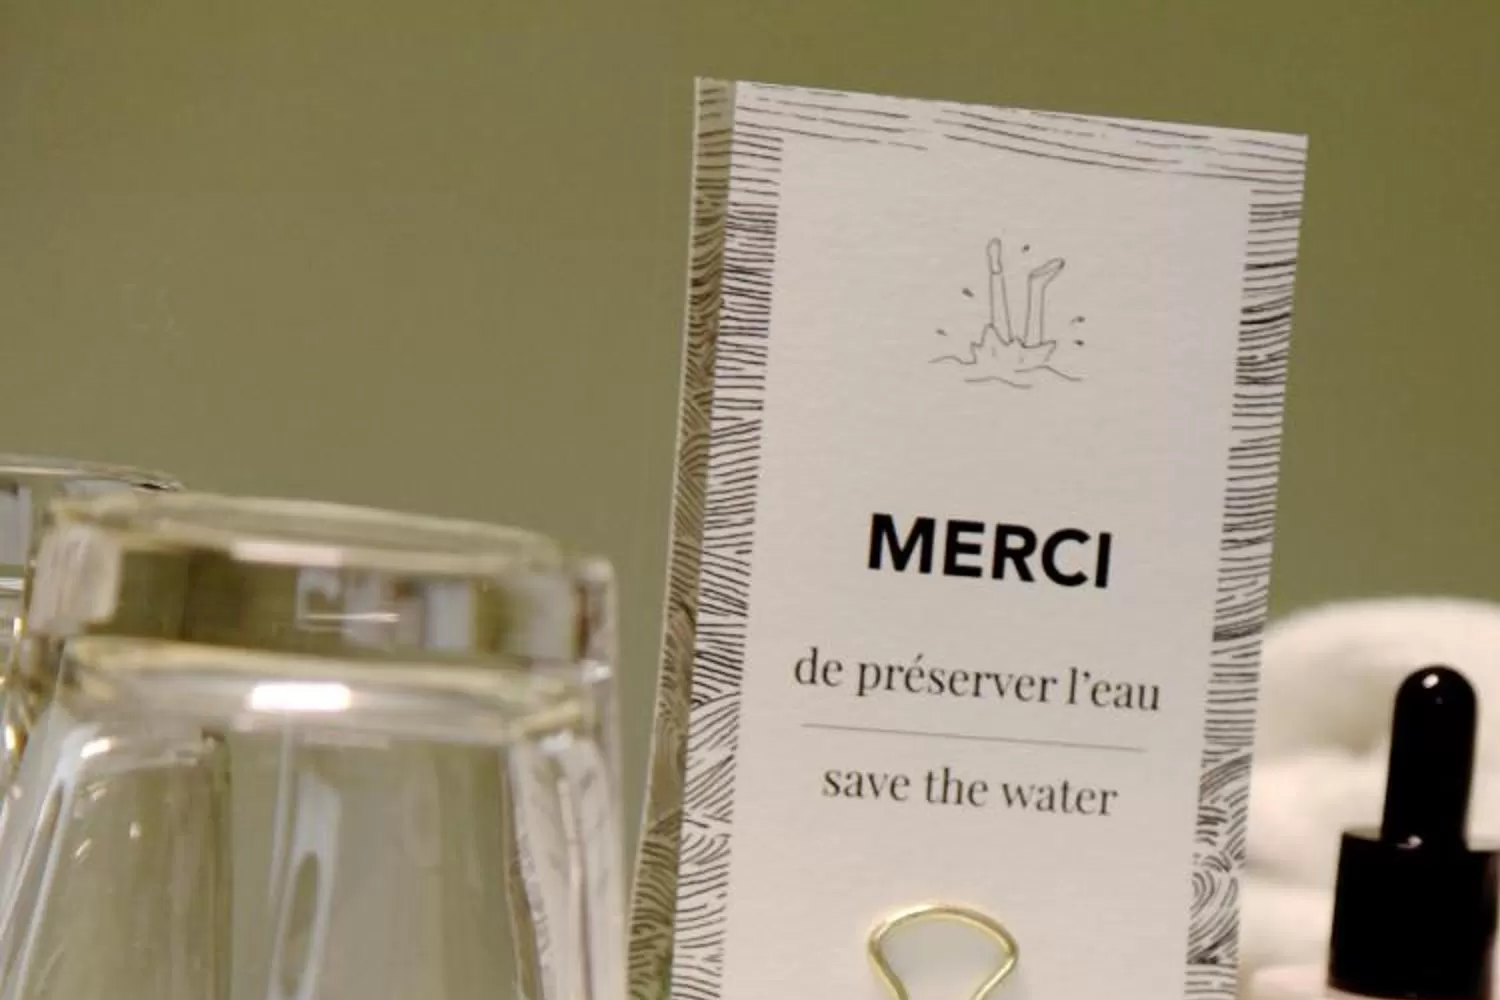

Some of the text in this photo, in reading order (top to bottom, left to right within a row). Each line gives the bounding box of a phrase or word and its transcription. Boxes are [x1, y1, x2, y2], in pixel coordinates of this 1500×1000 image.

[867, 511, 1113, 590] MERCI
[793, 646, 844, 688] de
[855, 653, 1059, 704] préserver
[822, 766, 1119, 818] save the water
